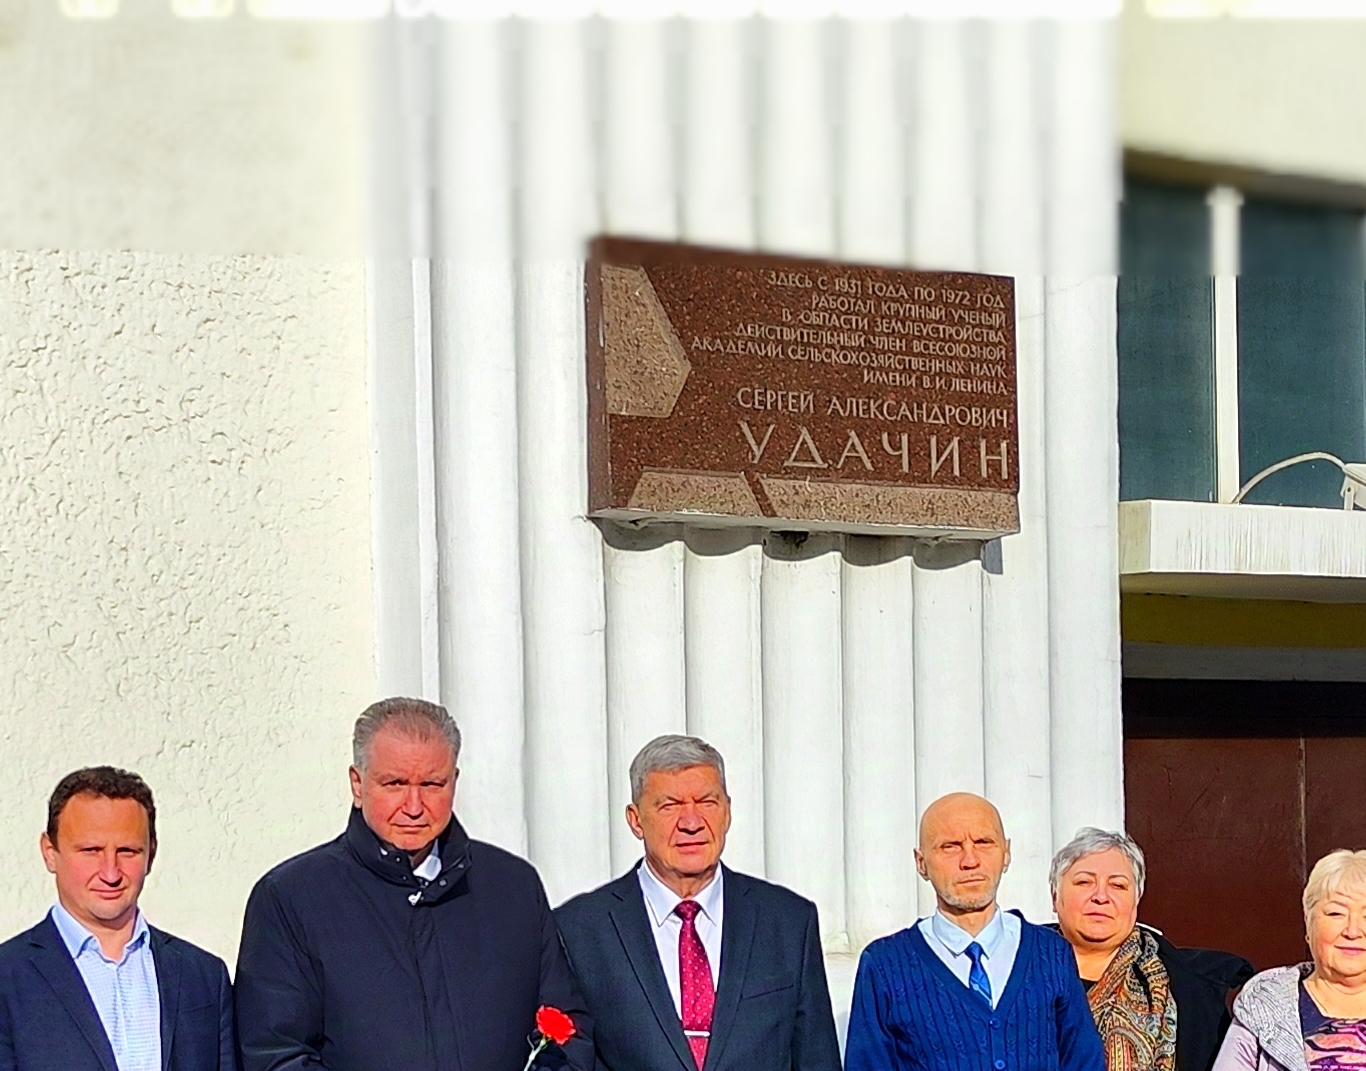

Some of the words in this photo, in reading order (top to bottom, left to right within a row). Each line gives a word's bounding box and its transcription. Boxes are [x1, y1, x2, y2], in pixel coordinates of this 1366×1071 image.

[767, 270, 813, 289] ЗДЕСЬ
[818, 276, 828, 291] С
[835, 277, 861, 294] 1931
[869, 281, 909, 299] ГОДА
[915, 286, 935, 301] ПО
[942, 289, 971, 305] 1972
[977, 293, 1005, 309] ГОД
[782, 308, 792, 323] В
[875, 317, 1006, 345] ЗЕМЛЕУСТРОЙСТВА
[812, 295, 875, 315] РАБОТАЛ
[881, 302, 946, 322] КРУПНЫЙ
[952, 309, 1006, 329] УЧЕНЫЙ
[691, 336, 784, 359] АКАДЕМИИ
[788, 345, 965, 375] СЕЛЬСКОХОЗЯЙСТВЕННЫХ
[971, 361, 1007, 379] НАУК
[735, 322, 865, 348] ДЕЙСТВИТЕЛЬНЫЙ
[870, 336, 906, 352] ЧЛЕН
[913, 340, 1006, 361] ВСЕСОЮЗНОЙ
[863, 369, 916, 388] ИМЕНИ
[951, 378, 1008, 396] ЛЕНИНА
[737, 387, 815, 414] СЕРГЕЙ
[827, 396, 1008, 428] АЛЕКСАНДРОВИЧ
[738, 419, 1009, 480] УДАЧИН
